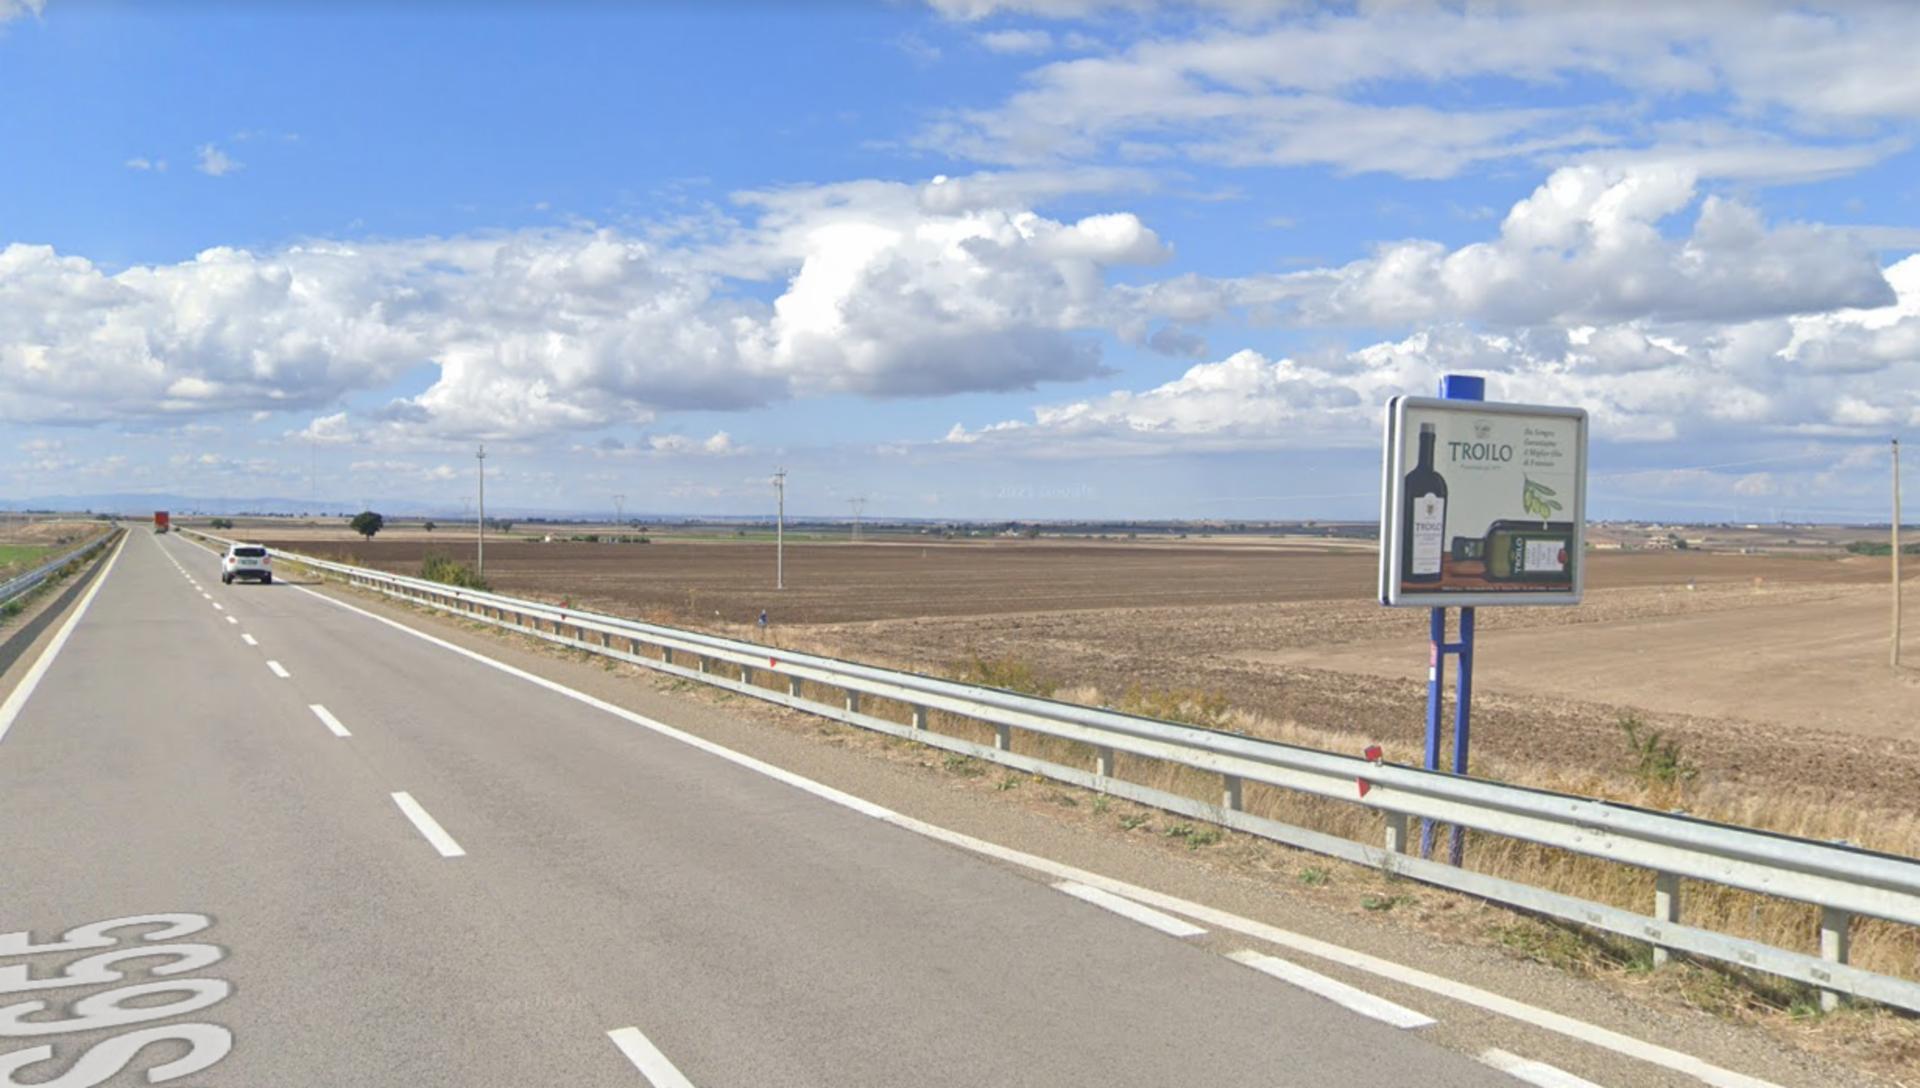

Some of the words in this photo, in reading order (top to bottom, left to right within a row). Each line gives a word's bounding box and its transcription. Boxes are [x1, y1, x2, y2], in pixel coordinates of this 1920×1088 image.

[1448, 441, 1513, 462] TROILO
[1415, 522, 1441, 532] TROILO
[1514, 537, 1524, 574] TROILO
